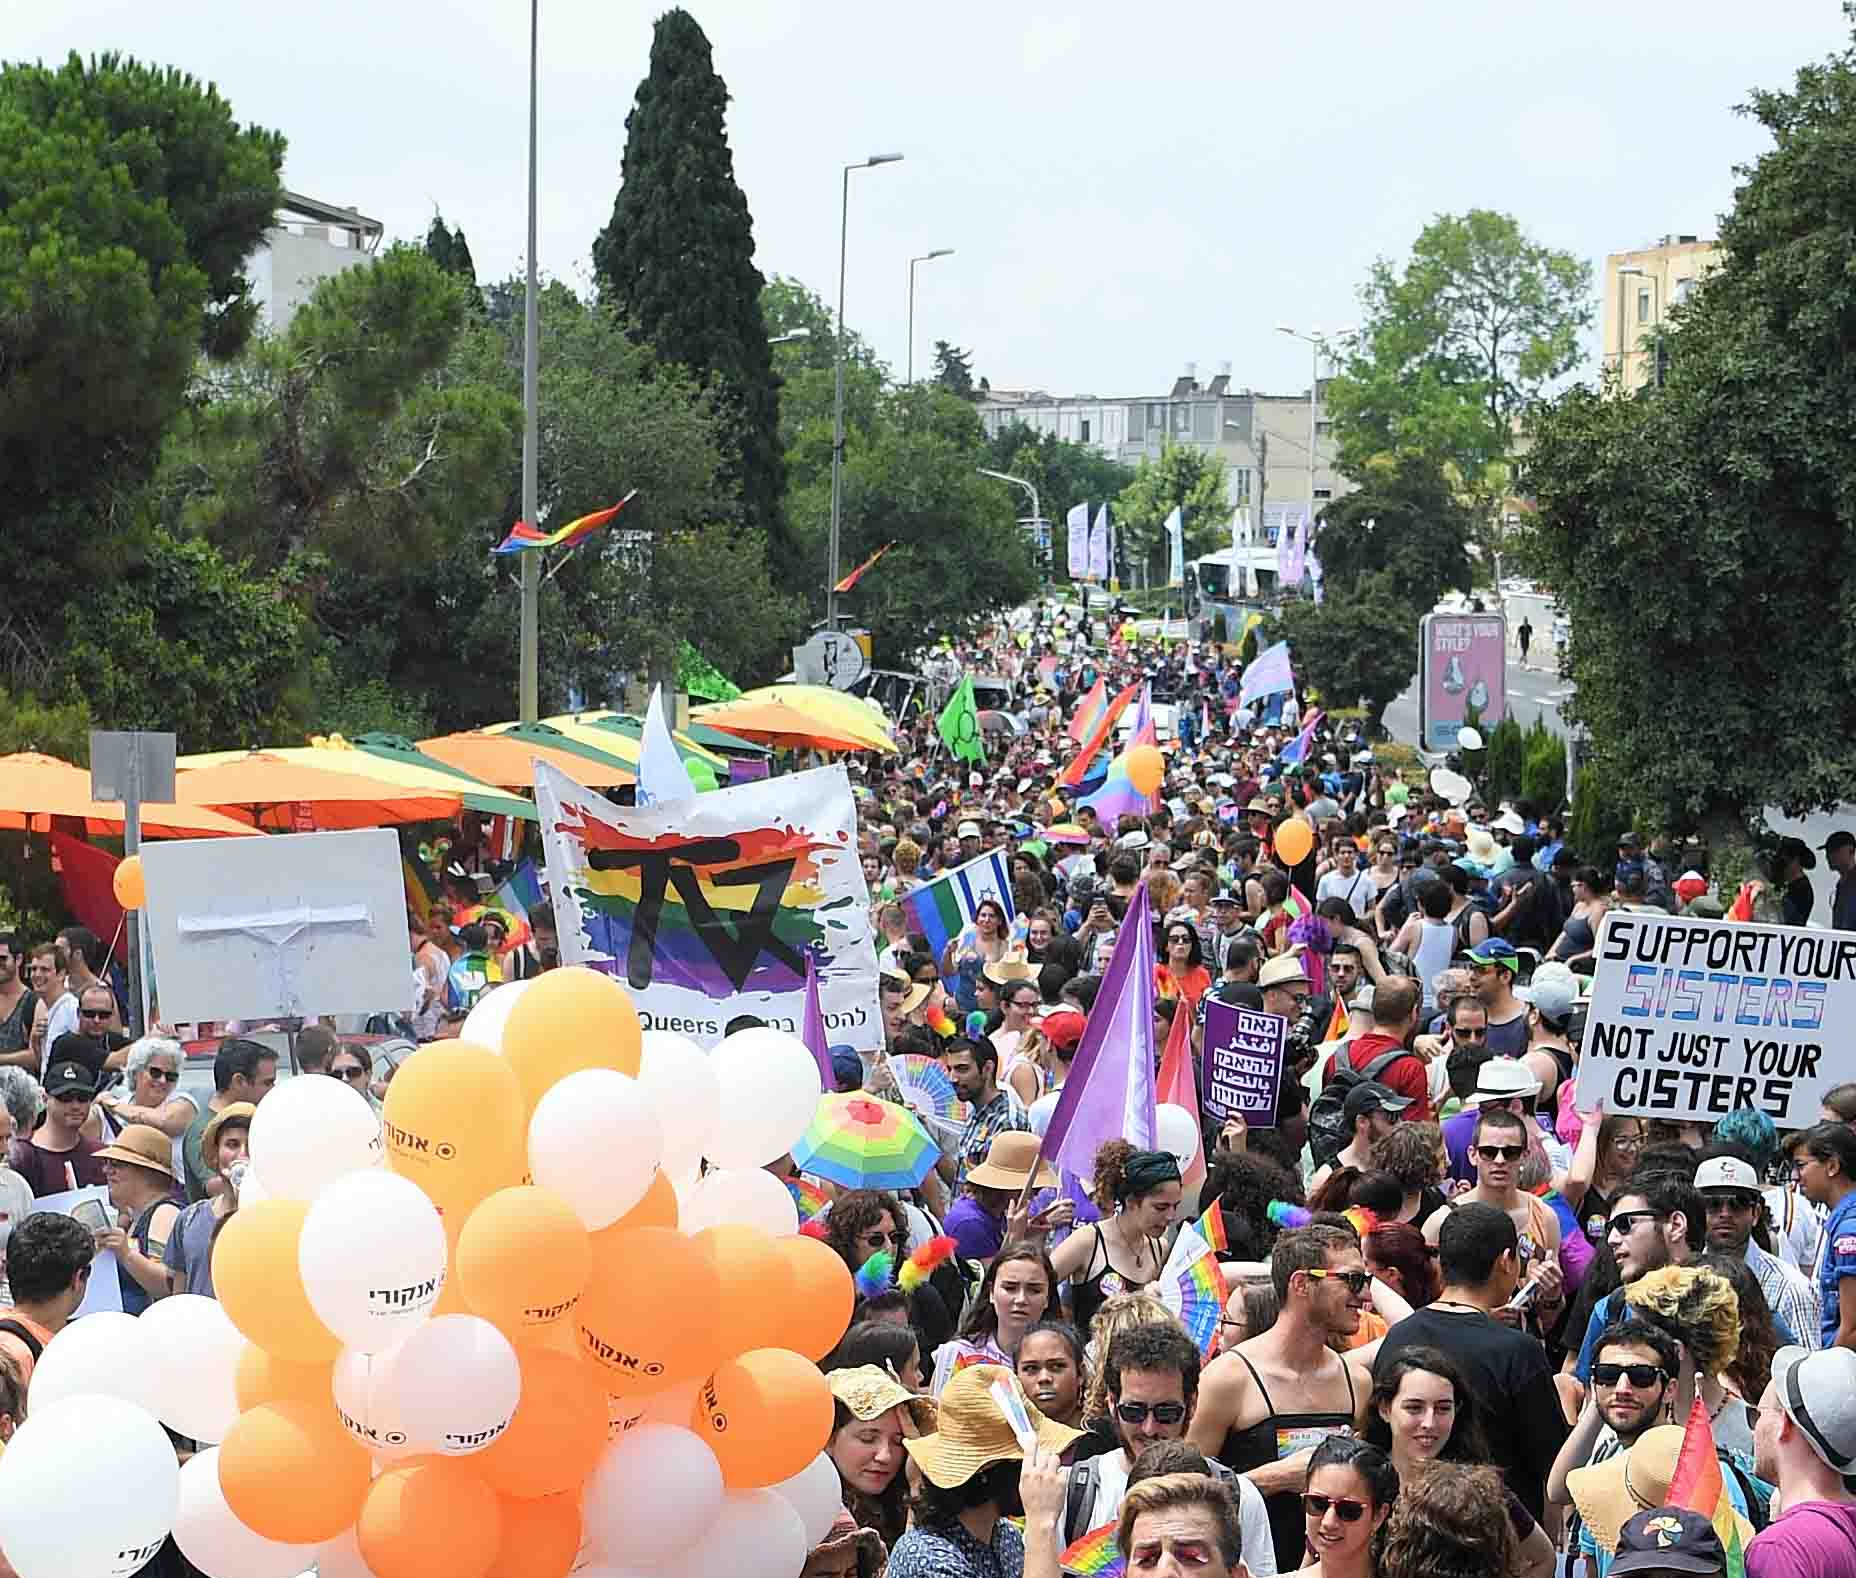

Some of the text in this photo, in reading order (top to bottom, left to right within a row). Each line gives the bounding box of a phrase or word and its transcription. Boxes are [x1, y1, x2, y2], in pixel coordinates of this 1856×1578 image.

[1621, 964, 1828, 1030] SISTERS
[822, 1007, 867, 1030] להט
[1239, 1012, 1280, 1037] גאה
[1590, 1021, 1822, 1078] NOT JUST YOUR
[1612, 1066, 1793, 1119] CISTERS
[369, 1278, 435, 1307] אנקורי
